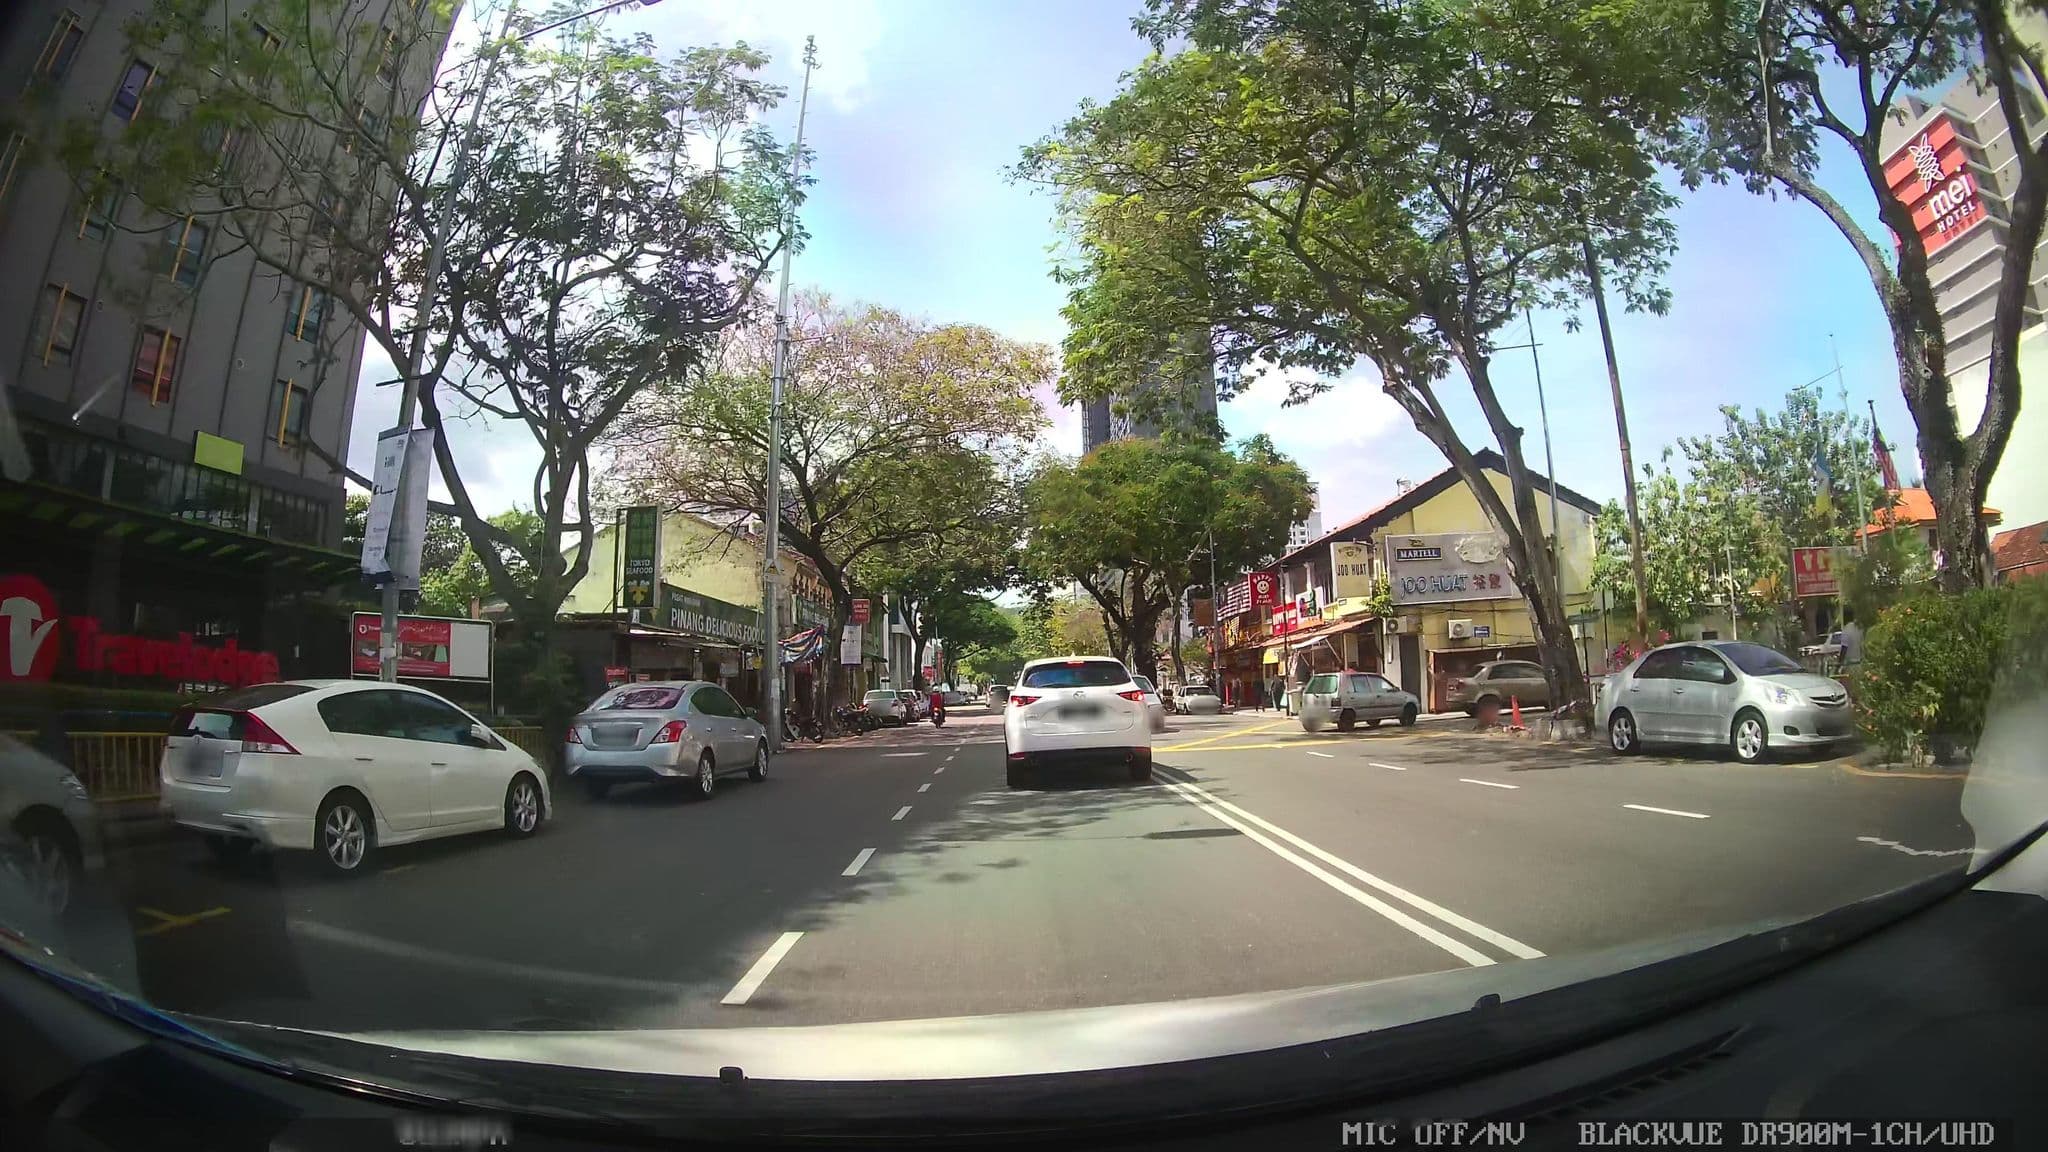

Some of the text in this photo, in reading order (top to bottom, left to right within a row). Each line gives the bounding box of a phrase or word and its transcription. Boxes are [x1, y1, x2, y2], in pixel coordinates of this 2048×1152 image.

[1929, 166, 1972, 220] mei
[1937, 201, 1976, 233] HOTEL
[1400, 549, 1438, 559] MARTELL
[626, 567, 654, 575] SEAFOOD
[1337, 563, 1367, 576] JOO HUAT
[1401, 572, 1468, 600] JOO HUAT
[671, 607, 704, 633] PINANG
[706, 615, 742, 640] DELICIOUS
